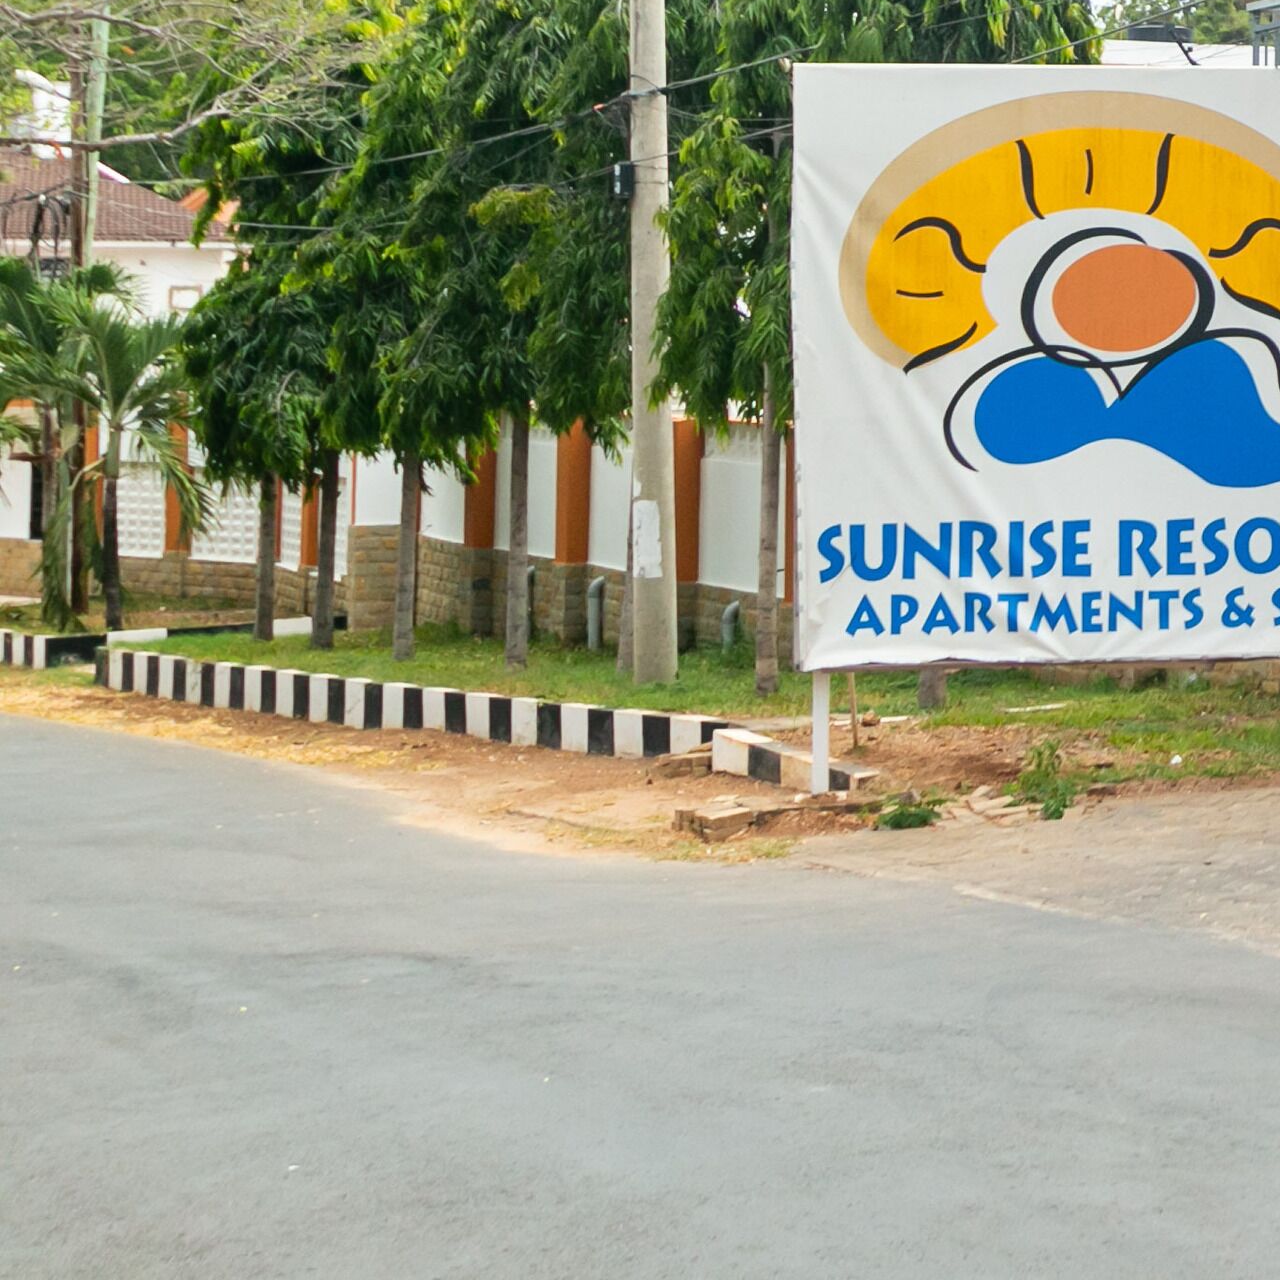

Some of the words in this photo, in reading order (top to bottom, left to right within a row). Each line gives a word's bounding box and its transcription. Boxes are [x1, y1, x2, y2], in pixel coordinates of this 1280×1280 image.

[817, 520, 1092, 583] SUNRISE
[846, 587, 1204, 636] APARTMENTS
[1221, 587, 1254, 628] &
